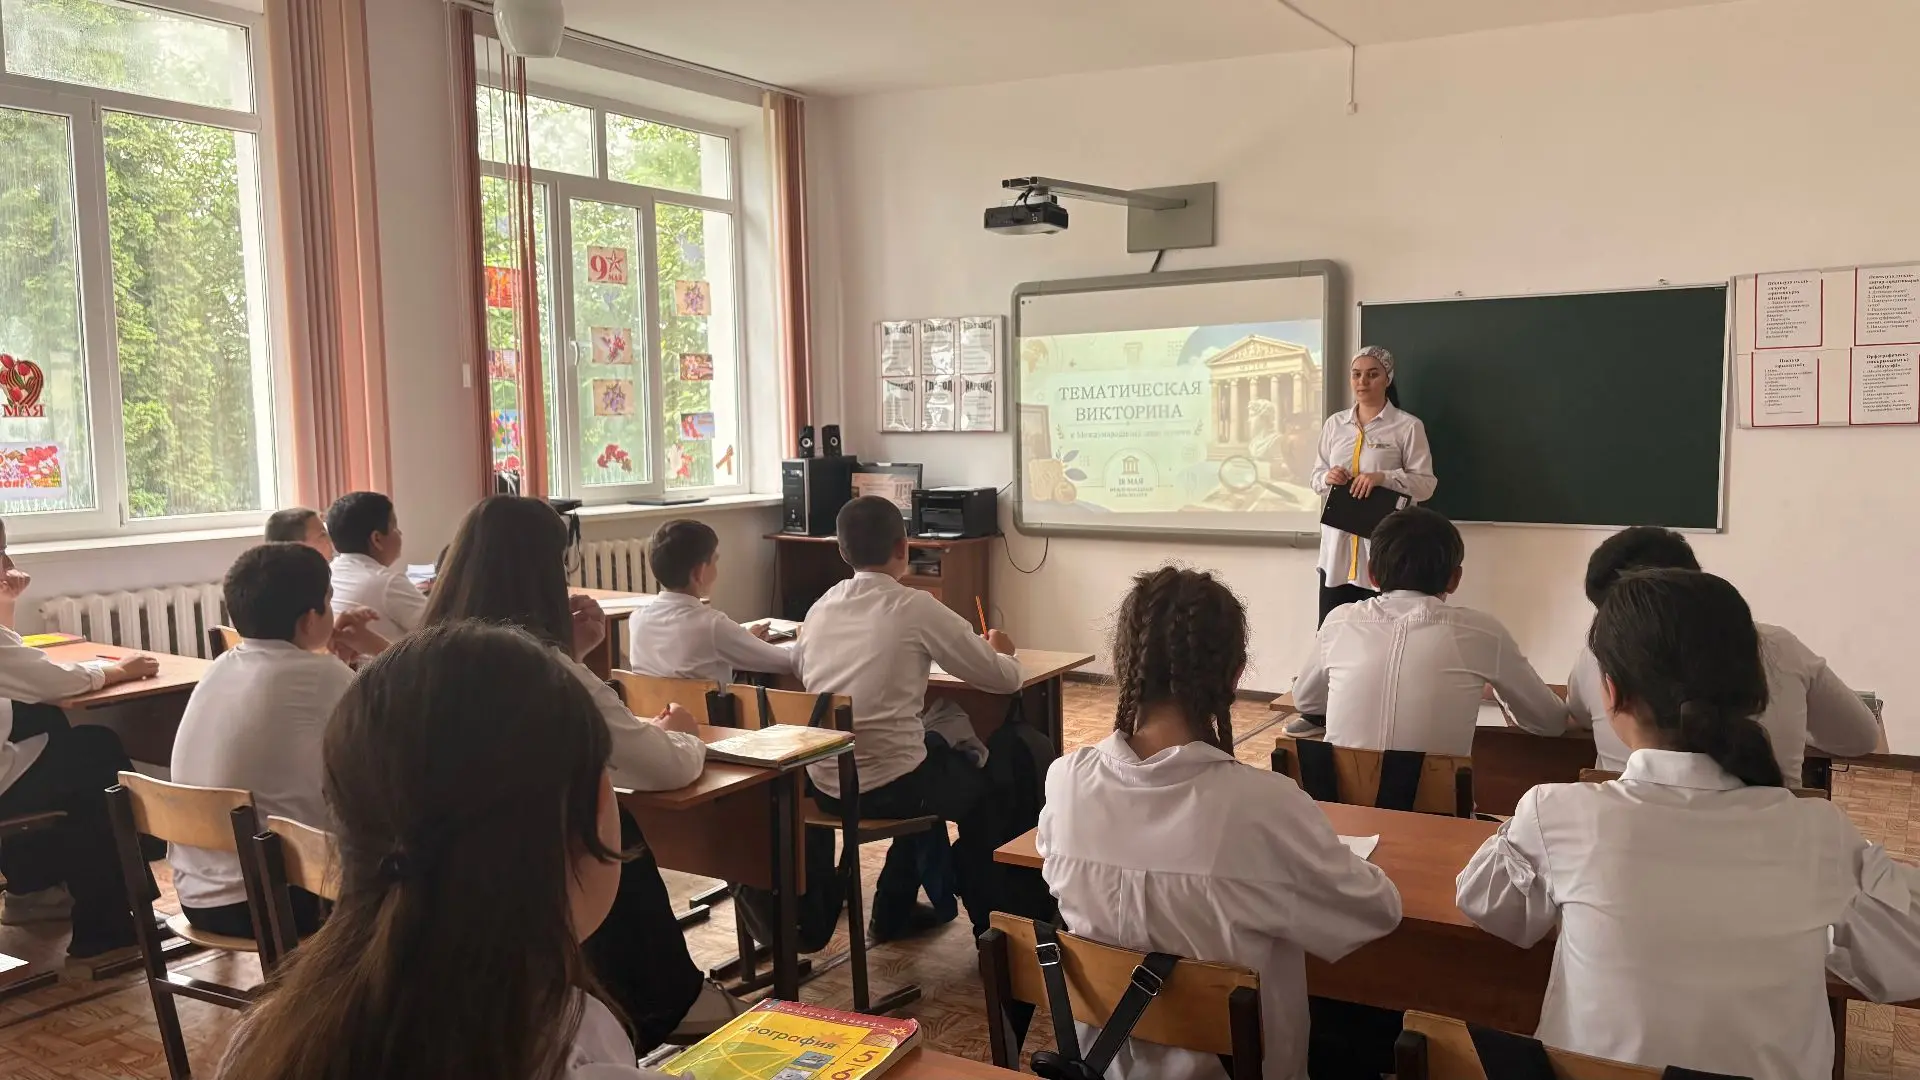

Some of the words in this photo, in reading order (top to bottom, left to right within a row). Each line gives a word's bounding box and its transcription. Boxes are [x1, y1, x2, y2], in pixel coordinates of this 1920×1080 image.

[591, 255, 607, 280] 9
[1058, 380, 1202, 401] ТЕМАТИЧЕСКАЯ
[2, 403, 46, 417] МАЯ
[1076, 403, 1183, 421] ВИКТОРИНА
[852, 1049, 880, 1063] 5
[831, 1067, 856, 1080] 6
